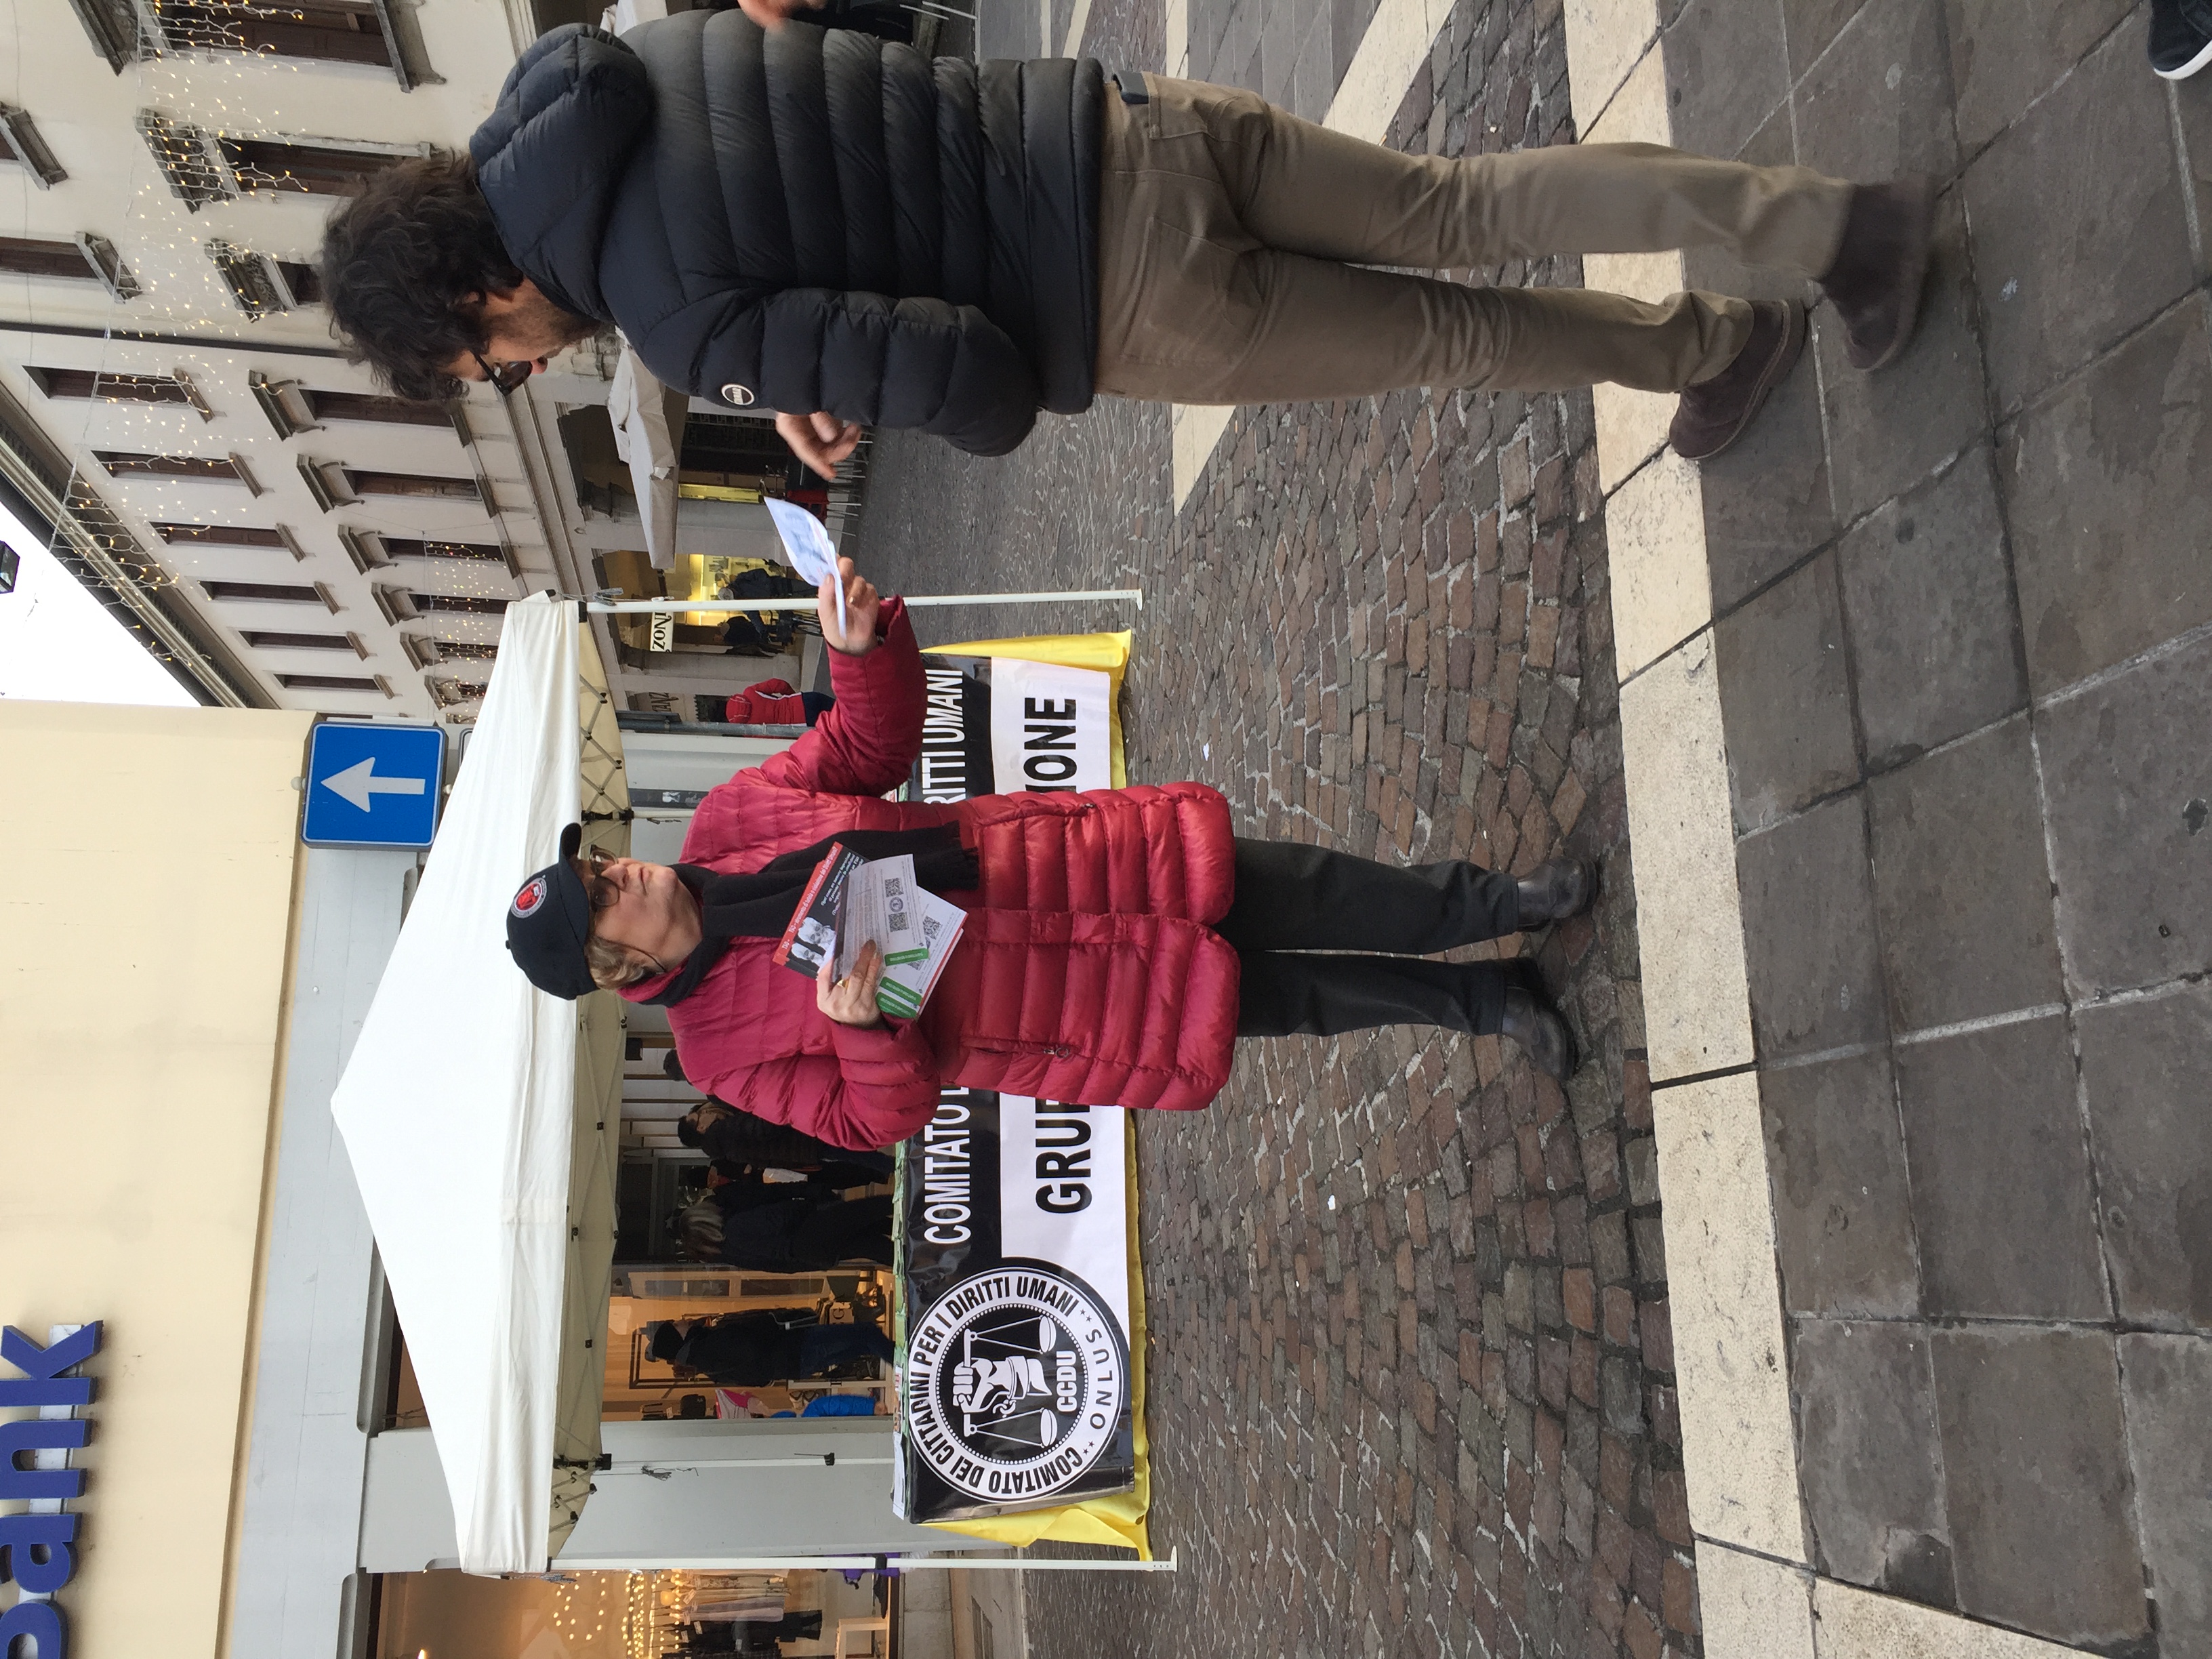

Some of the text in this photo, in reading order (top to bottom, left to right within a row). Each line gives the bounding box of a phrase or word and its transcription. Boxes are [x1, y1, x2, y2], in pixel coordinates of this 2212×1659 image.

[652, 611, 672, 652] ZONI
[922, 669, 965, 743] UMANI
[924, 1104, 971, 1244] COMITATO
[910, 1276, 1082, 1494] COMITATO DEI CITTADINI PER I DIRITTI UMANI
[1057, 1350, 1078, 1412] CCDU
[1085, 1329, 1113, 1429] ONLUS
